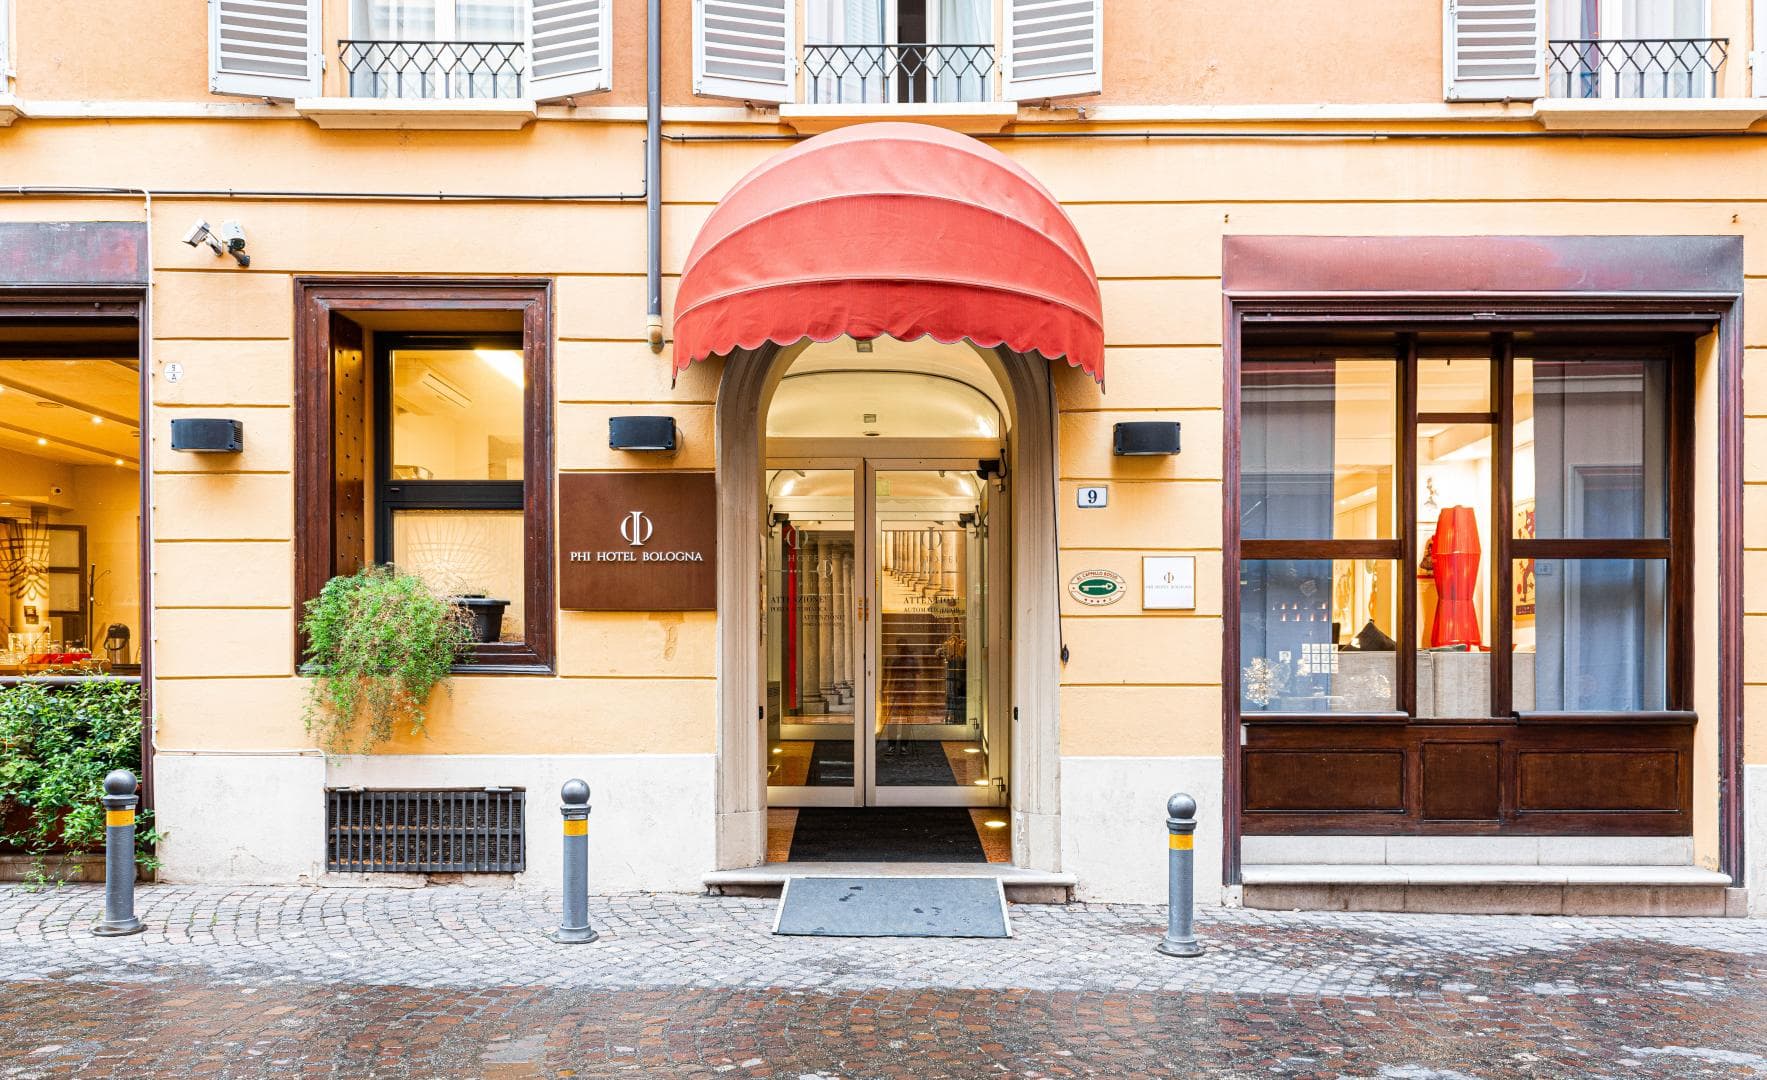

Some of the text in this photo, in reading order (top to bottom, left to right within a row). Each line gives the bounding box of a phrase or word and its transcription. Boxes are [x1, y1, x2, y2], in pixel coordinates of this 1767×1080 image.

[1087, 489, 1098, 504] 9
[570, 551, 704, 562] PHI HOTEL BOLOGNA
